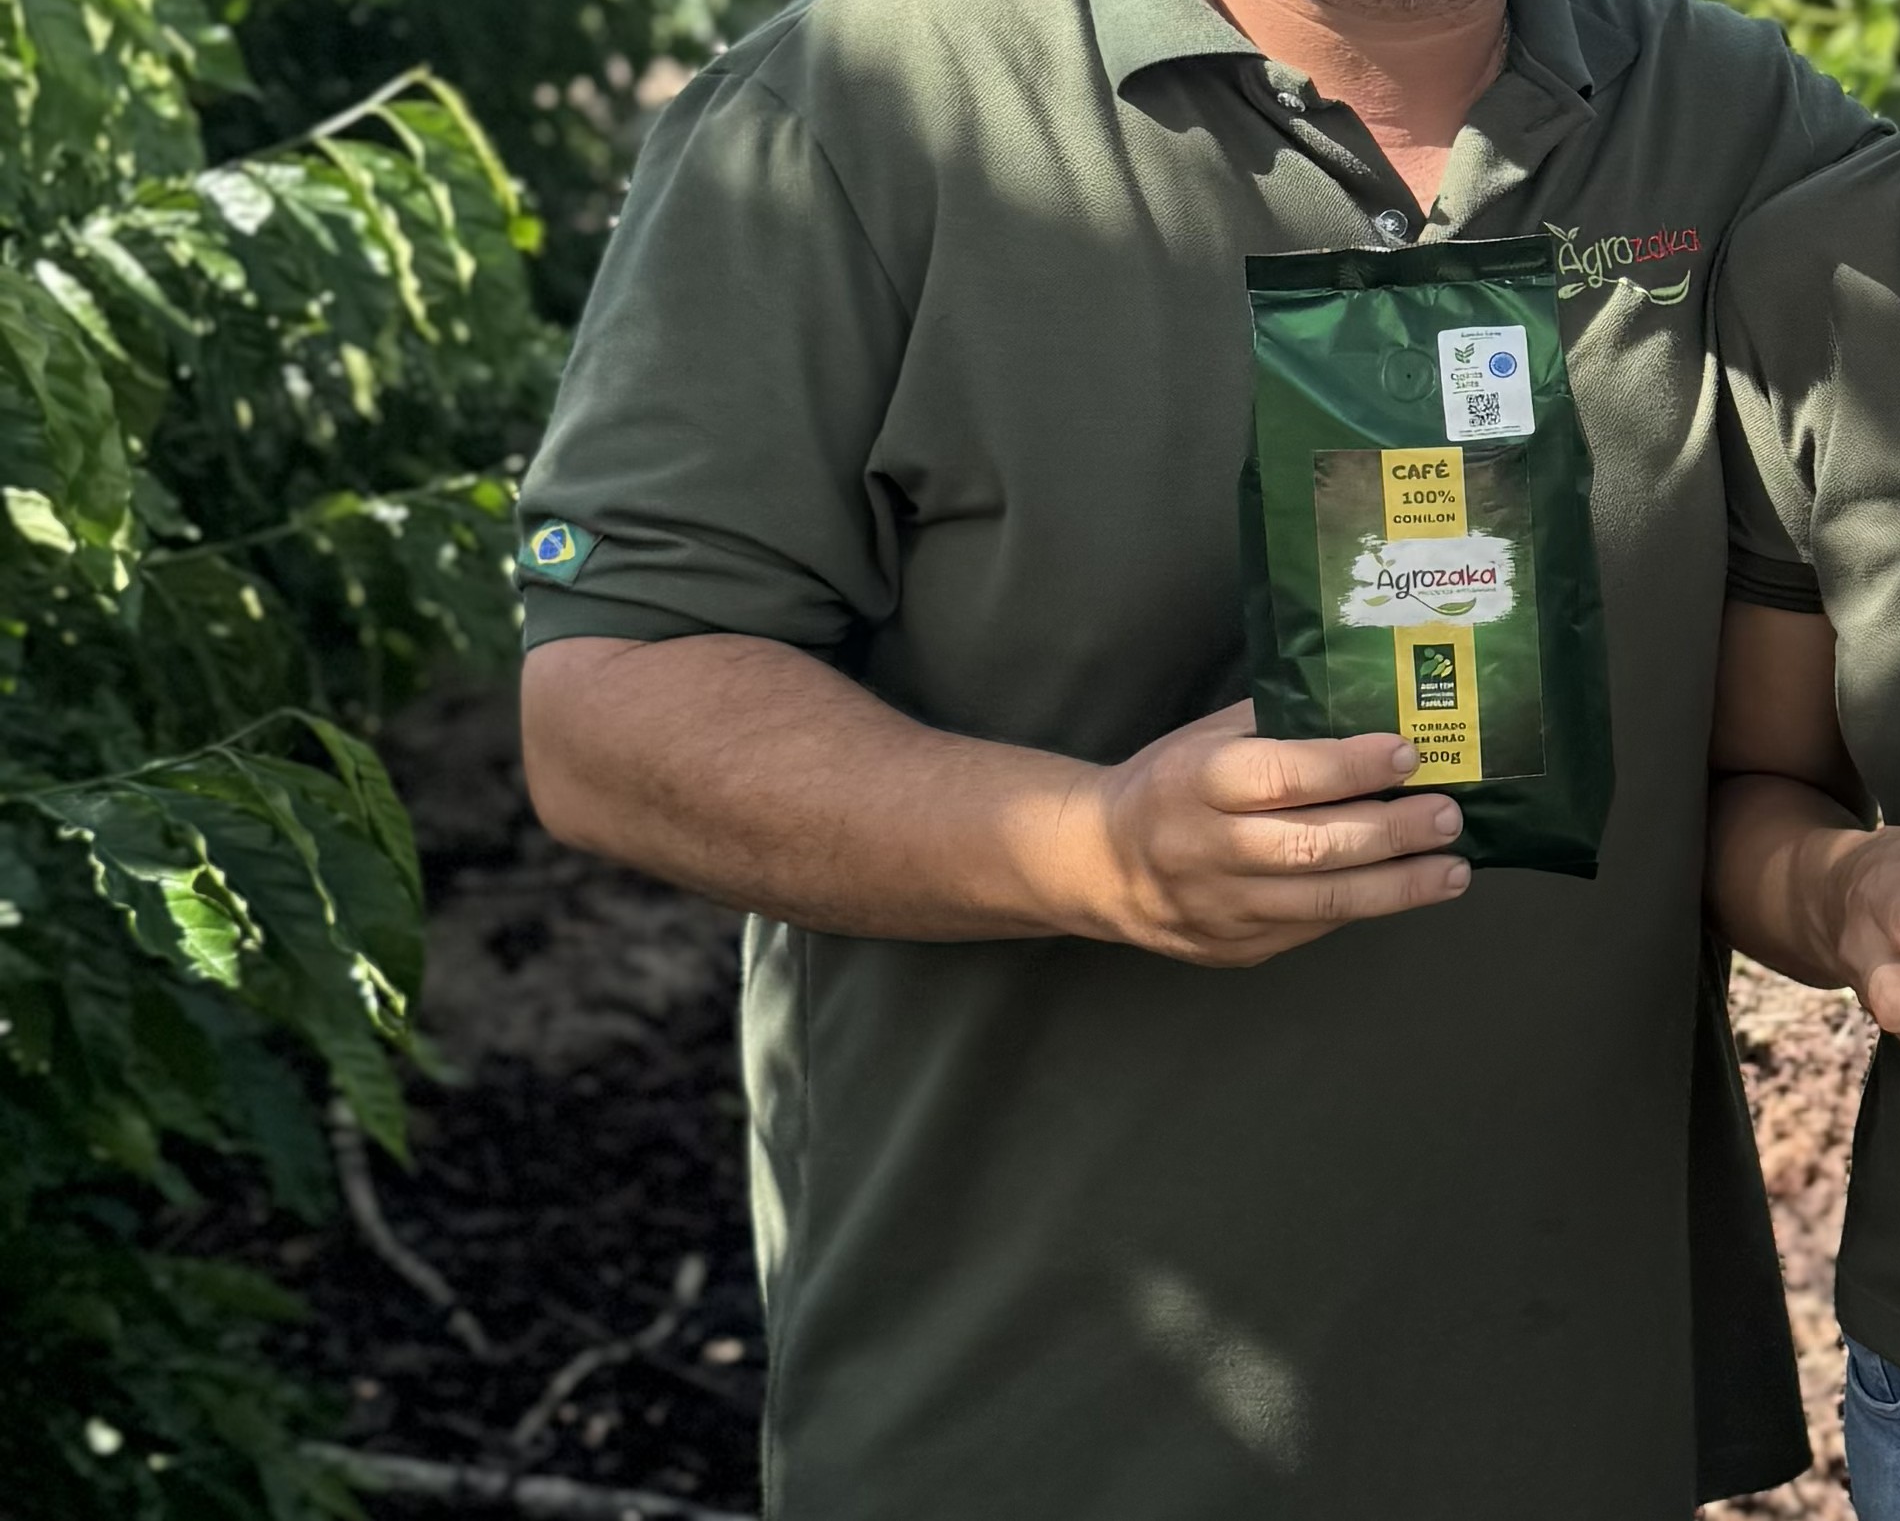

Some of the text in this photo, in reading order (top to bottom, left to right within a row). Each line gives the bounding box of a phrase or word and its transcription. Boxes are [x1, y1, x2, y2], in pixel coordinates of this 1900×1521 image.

[1558, 223, 1700, 288] Agrozaka
[1391, 459, 1451, 481] CAFÉ
[1402, 490, 1456, 505] 100%
[1393, 513, 1456, 525] CONILON
[1377, 564, 1497, 599] Agrozaka
[1411, 722, 1467, 731] TORRADO
[1413, 733, 1466, 744] EM GRÃO
[1419, 750, 1461, 765] 500g
